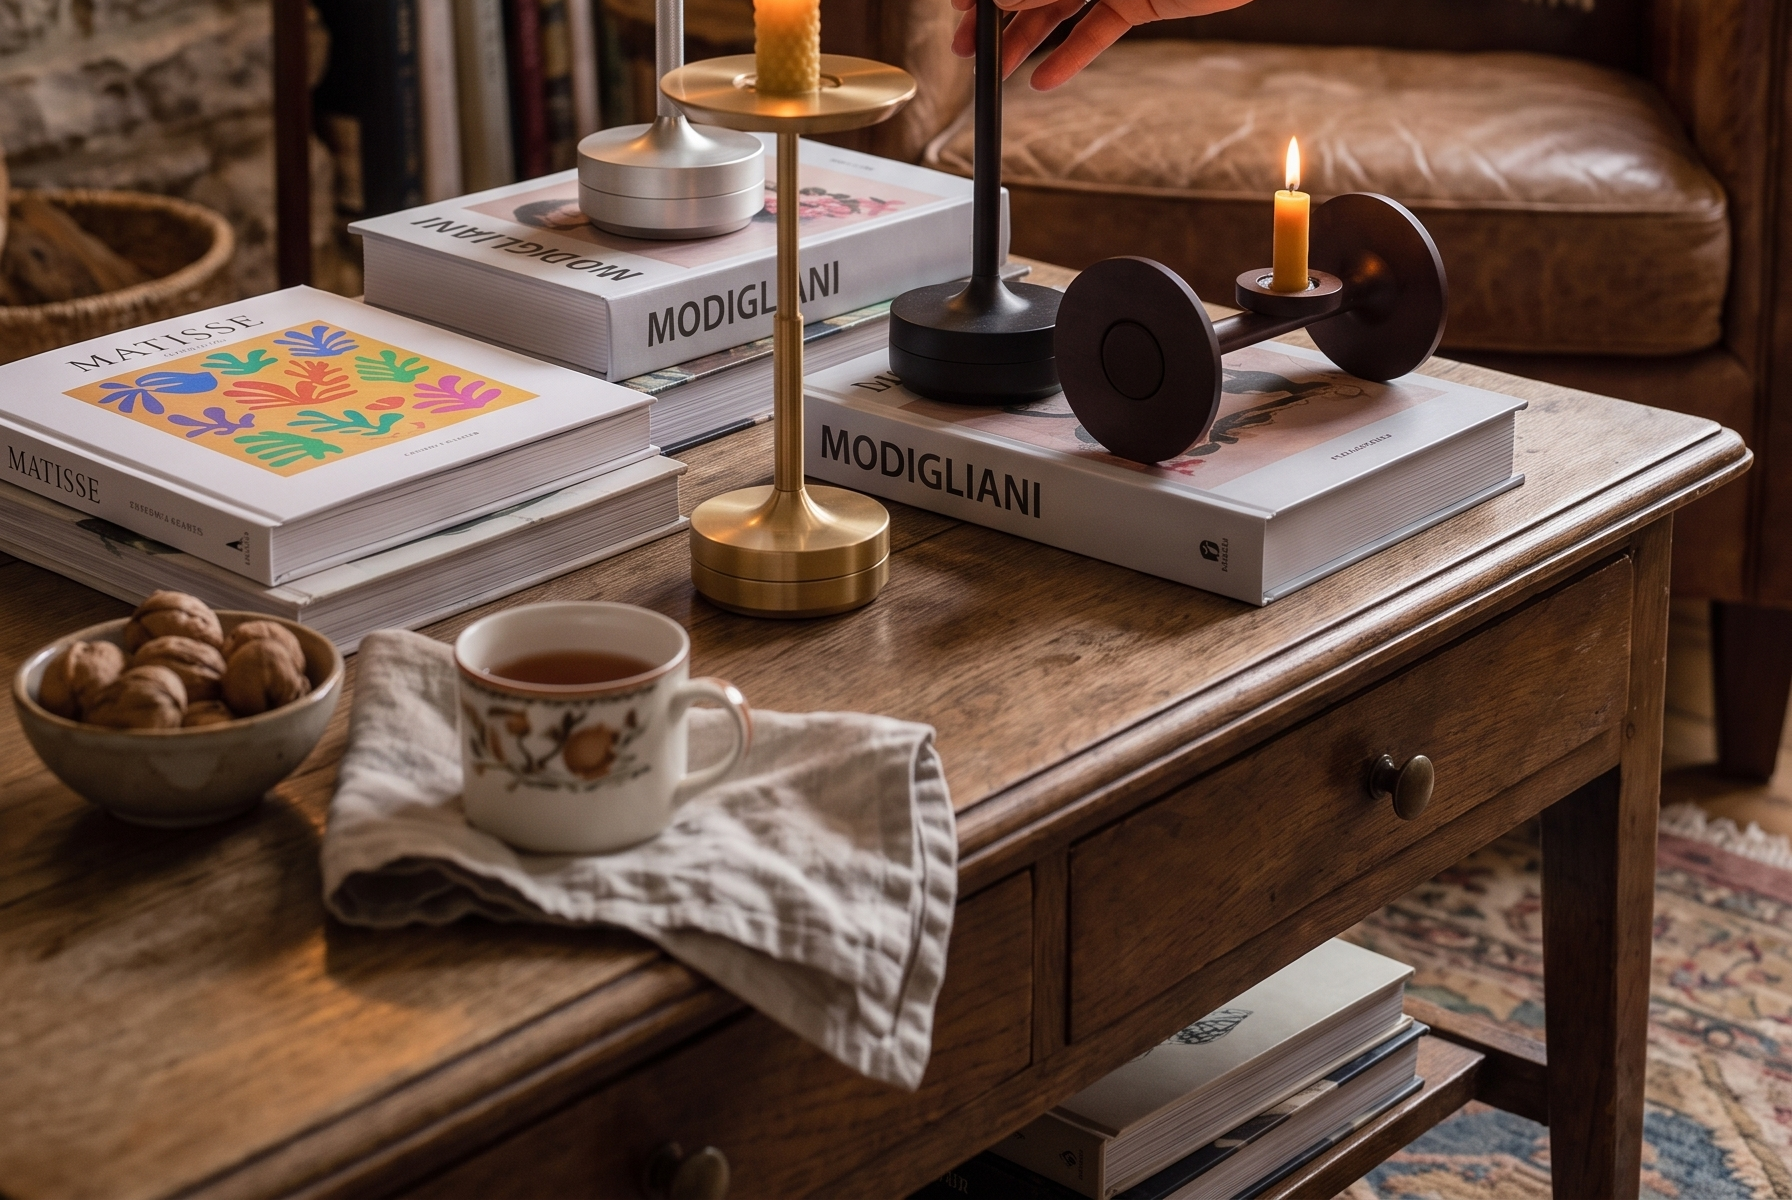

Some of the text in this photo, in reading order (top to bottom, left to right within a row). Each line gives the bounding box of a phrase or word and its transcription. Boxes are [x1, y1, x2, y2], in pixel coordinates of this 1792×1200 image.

[410, 217, 645, 282] MODIGLIANI
[648, 260, 839, 347] MODIGLNI
[65, 315, 264, 372] MATISSE
[7, 445, 101, 504] MATISSE
[821, 424, 1041, 519] MODIGLIANI
